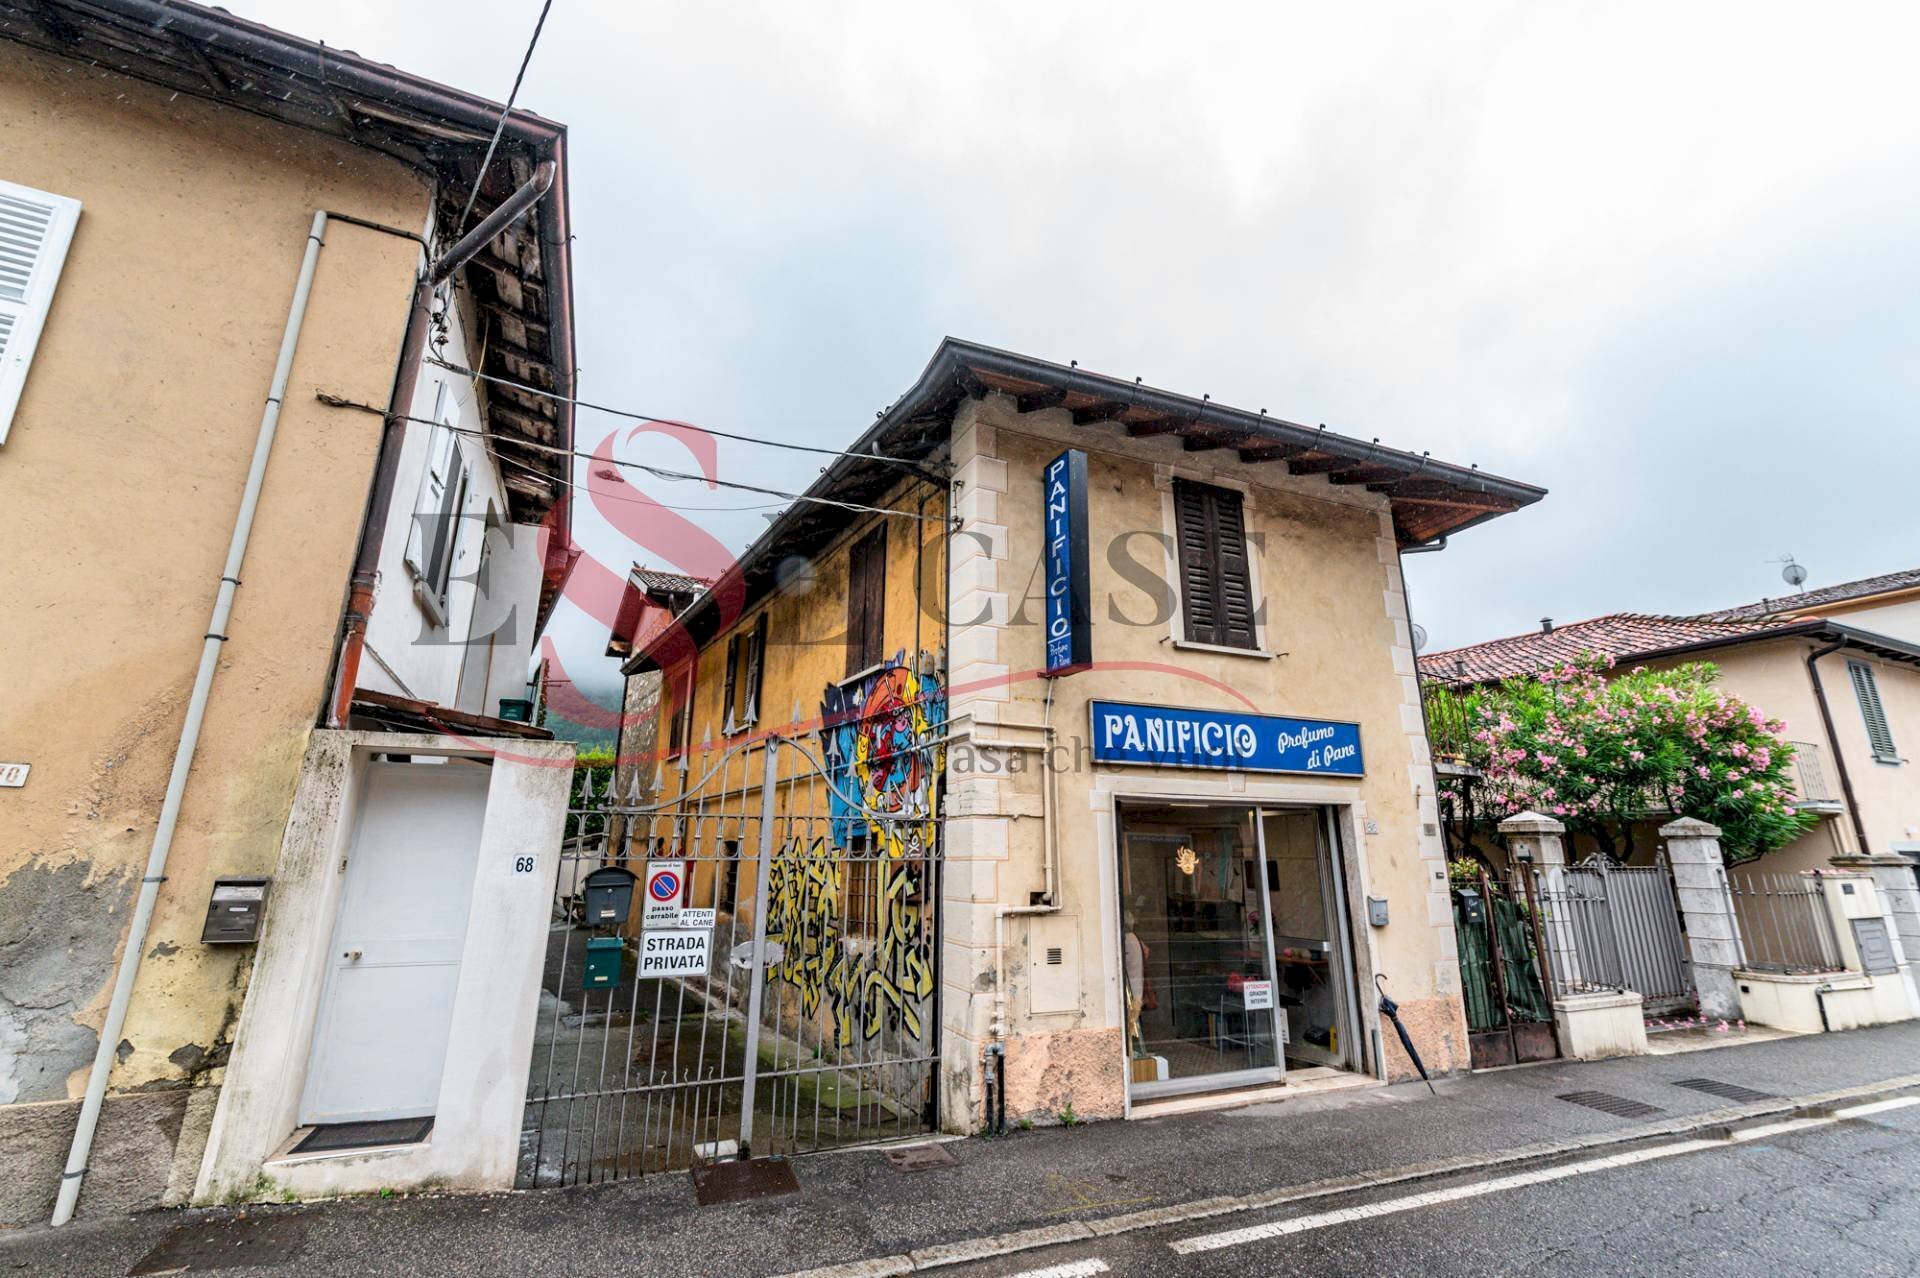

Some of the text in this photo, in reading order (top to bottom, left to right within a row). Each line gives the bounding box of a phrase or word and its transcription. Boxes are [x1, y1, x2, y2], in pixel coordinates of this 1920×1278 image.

[1049, 459, 1069, 638] PANIFICIO
[1104, 714, 1258, 759] PANIFICIO
[1278, 726, 1335, 755] Profumo
[1307, 745, 1356, 770] di Pane
[515, 856, 534, 873] 68
[645, 912, 679, 920] carrabile
[682, 910, 714, 918] ATTENTI
[646, 936, 705, 952] STRADA
[644, 955, 704, 970] PRIVATA
